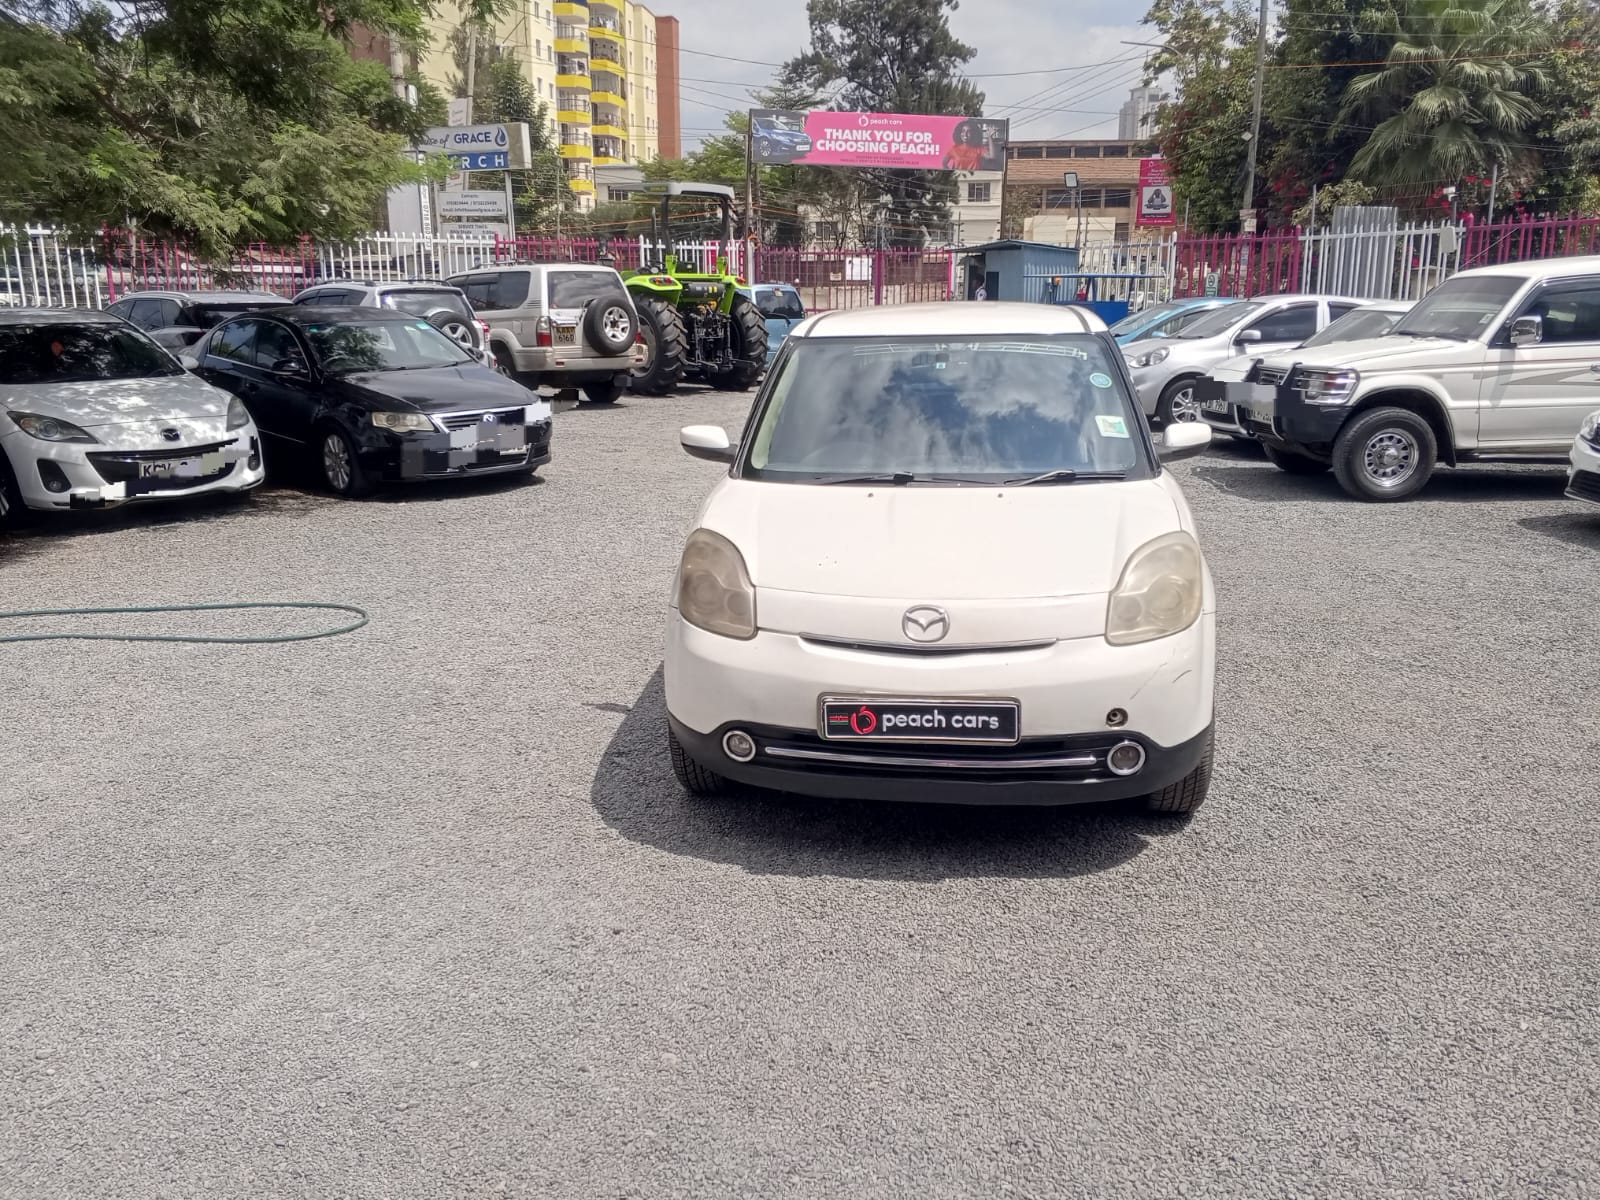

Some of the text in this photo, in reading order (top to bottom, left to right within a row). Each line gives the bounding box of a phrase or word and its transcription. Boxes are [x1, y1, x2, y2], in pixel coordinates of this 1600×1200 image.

[870, 118, 888, 126] peach
[439, 133, 450, 148] of
[454, 131, 492, 144] GRACE
[824, 128, 933, 143] THANK YOU FOR
[816, 139, 940, 155] CHOOSING PEACH!
[450, 154, 504, 169] RCH
[882, 709, 1000, 732] peach cars
